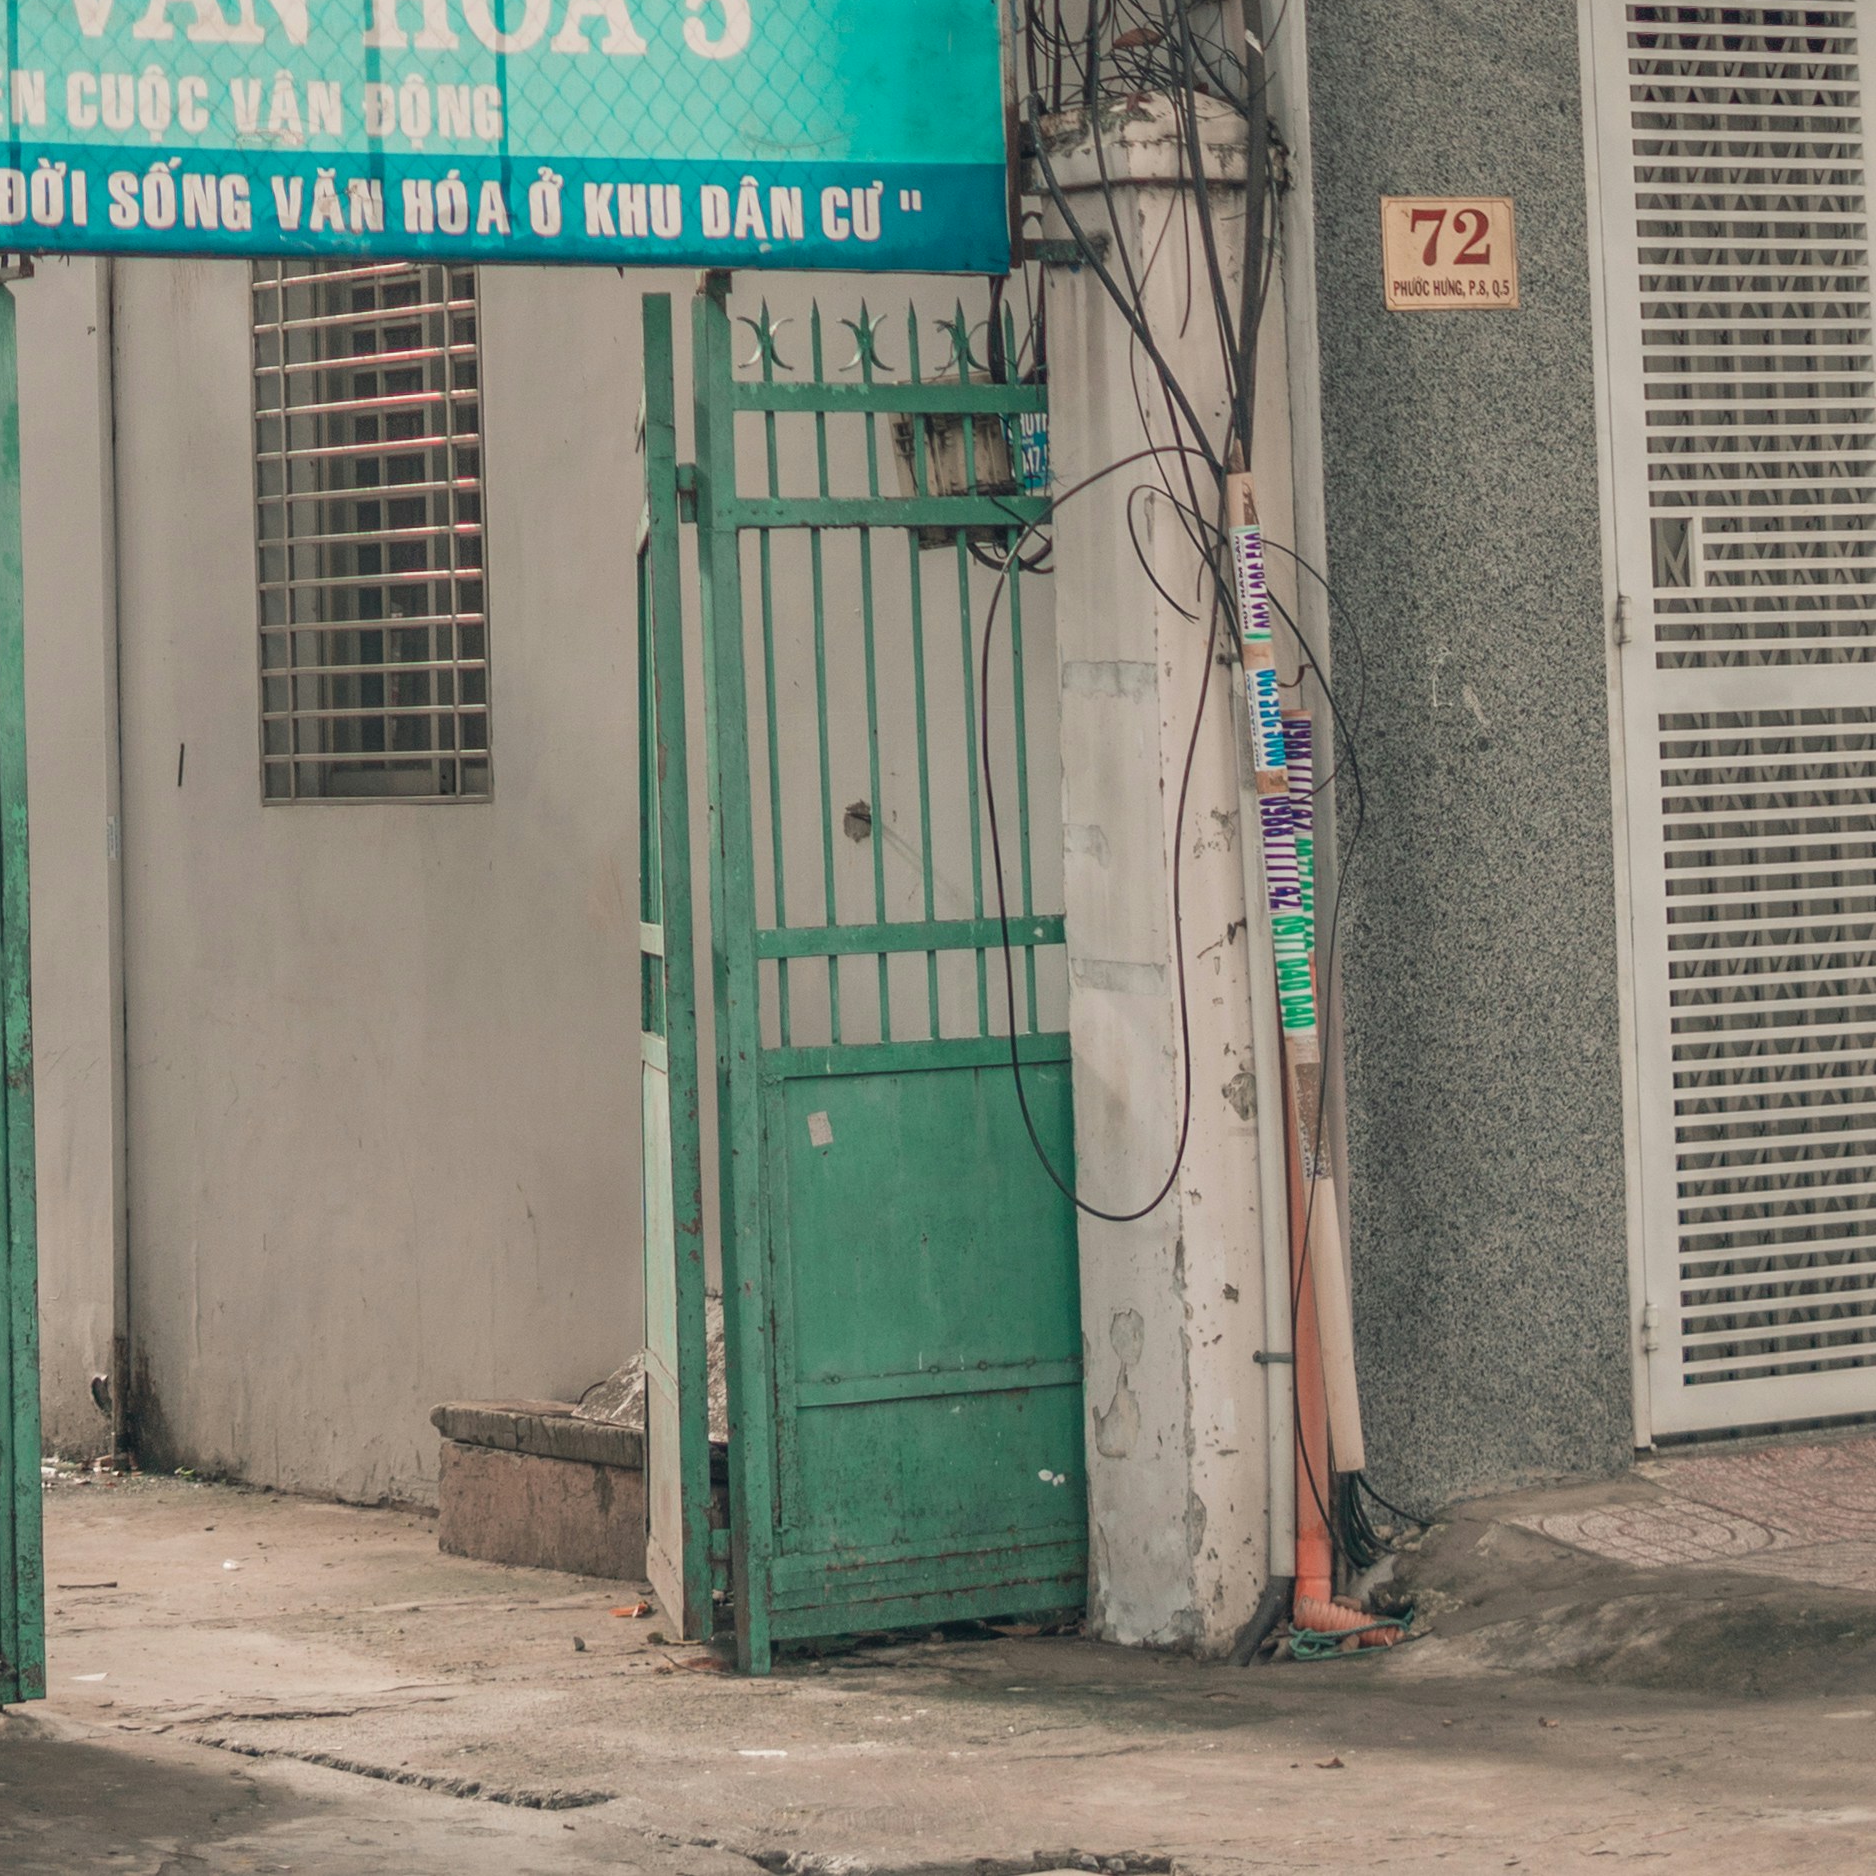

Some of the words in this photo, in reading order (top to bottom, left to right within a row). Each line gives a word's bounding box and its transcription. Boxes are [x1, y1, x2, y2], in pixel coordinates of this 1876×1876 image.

[66, 64, 210, 143] CUỘC
[361, 73, 505, 151] ĐỘNG
[108, 156, 252, 232] SỐNG
[271, 167, 385, 235] VĂN
[403, 169, 511, 236] HÓA
[529, 166, 565, 237] Ở
[583, 183, 682, 239] KHU
[701, 175, 803, 240] DÂN
[821, 181, 884, 242] CƯ
[1410, 208, 1491, 266] 72
[1393, 276, 1430, 296] PHƯỚC
[1433, 277, 1466, 298] HƯNG,
[1468, 280, 1490, 298] P.8,
[1492, 280, 1510, 298] Q.5
[1276, 958, 1312, 992] 040
[1281, 995, 1315, 1029] 040
